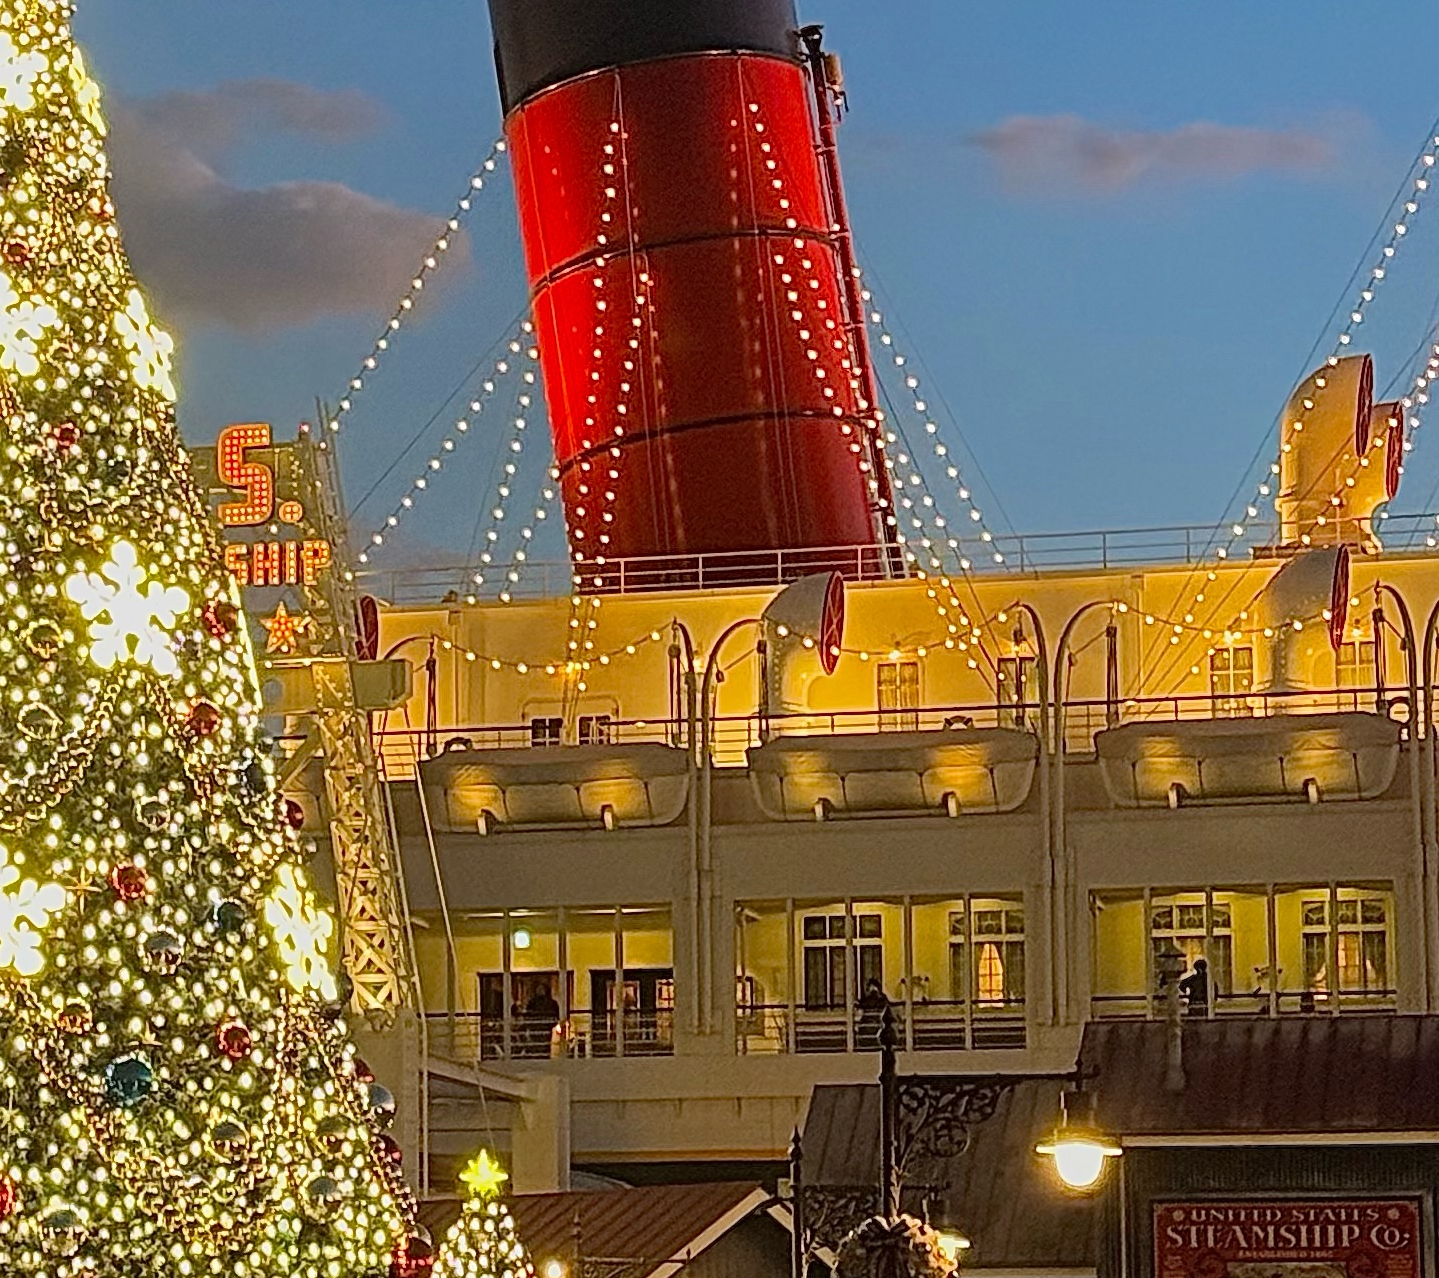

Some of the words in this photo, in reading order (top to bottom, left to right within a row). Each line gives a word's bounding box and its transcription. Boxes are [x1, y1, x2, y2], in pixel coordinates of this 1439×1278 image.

[1190, 1208, 1282, 1222] UNITED
[1290, 1208, 1380, 1222] STATES
[1165, 1224, 1361, 1249] STEAMSHIP
